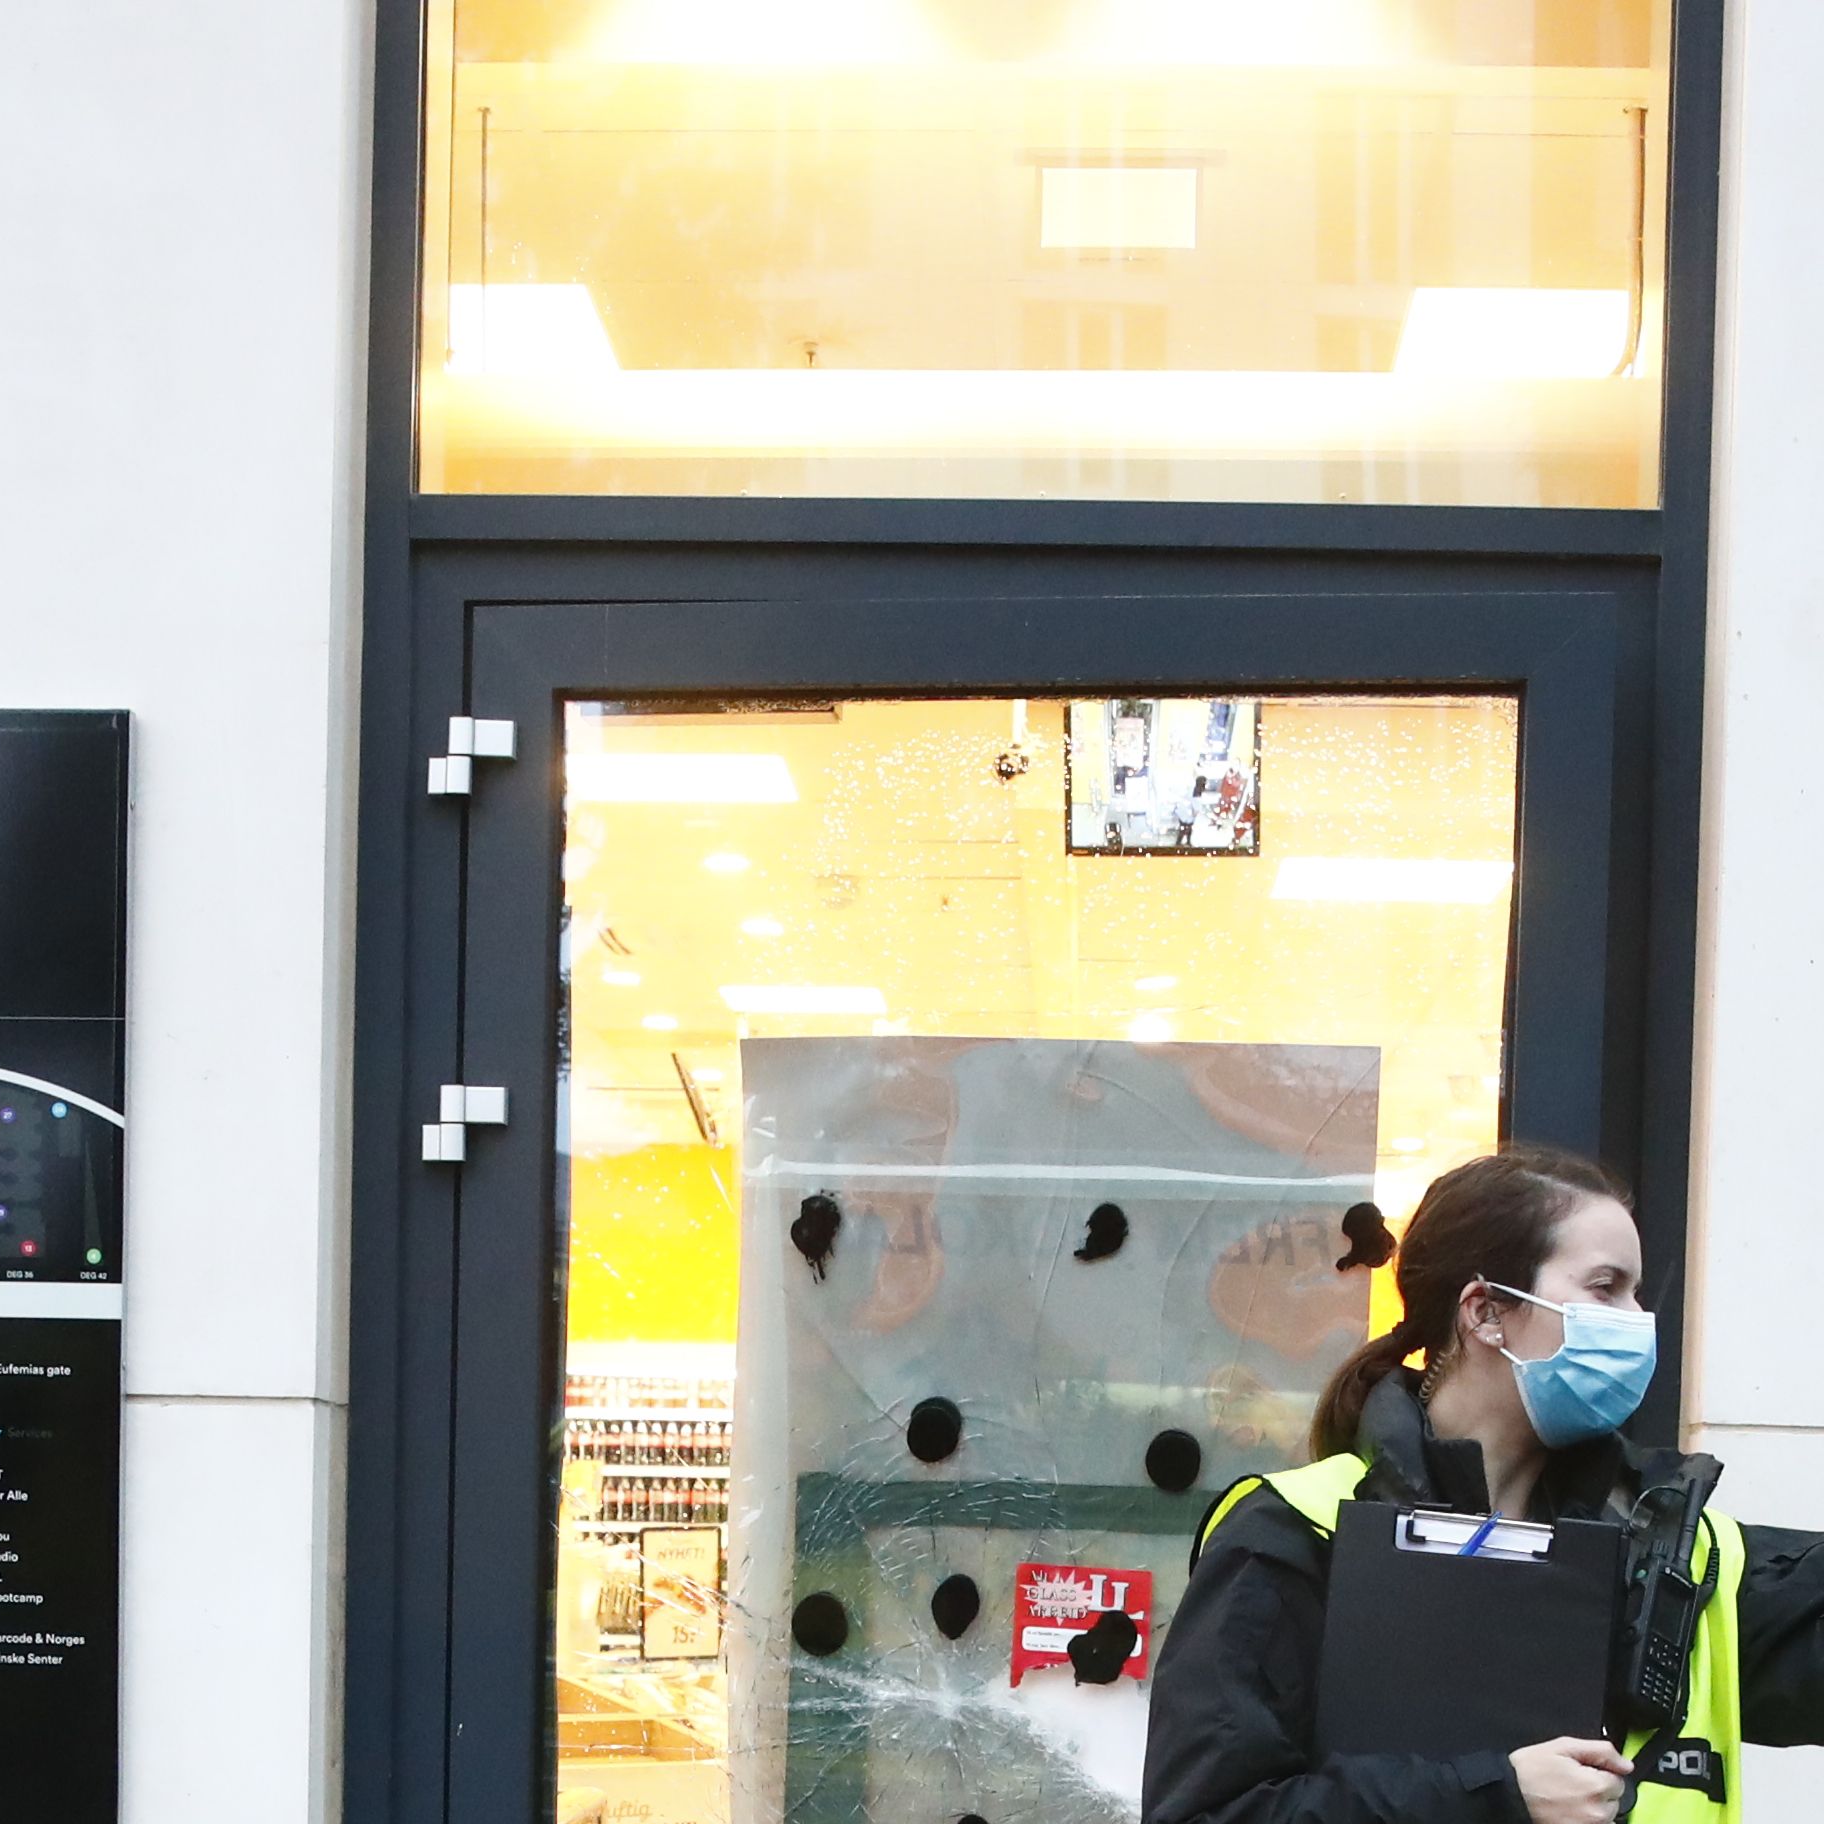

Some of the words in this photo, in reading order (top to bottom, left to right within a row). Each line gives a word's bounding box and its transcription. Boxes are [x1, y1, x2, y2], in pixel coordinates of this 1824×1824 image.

[47, 1366, 71, 1377] gate
[7, 1490, 28, 1501] Alle
[35, 1633, 43, 1643] &
[46, 1634, 85, 1646] Norges
[28, 1653, 62, 1664] Senter
